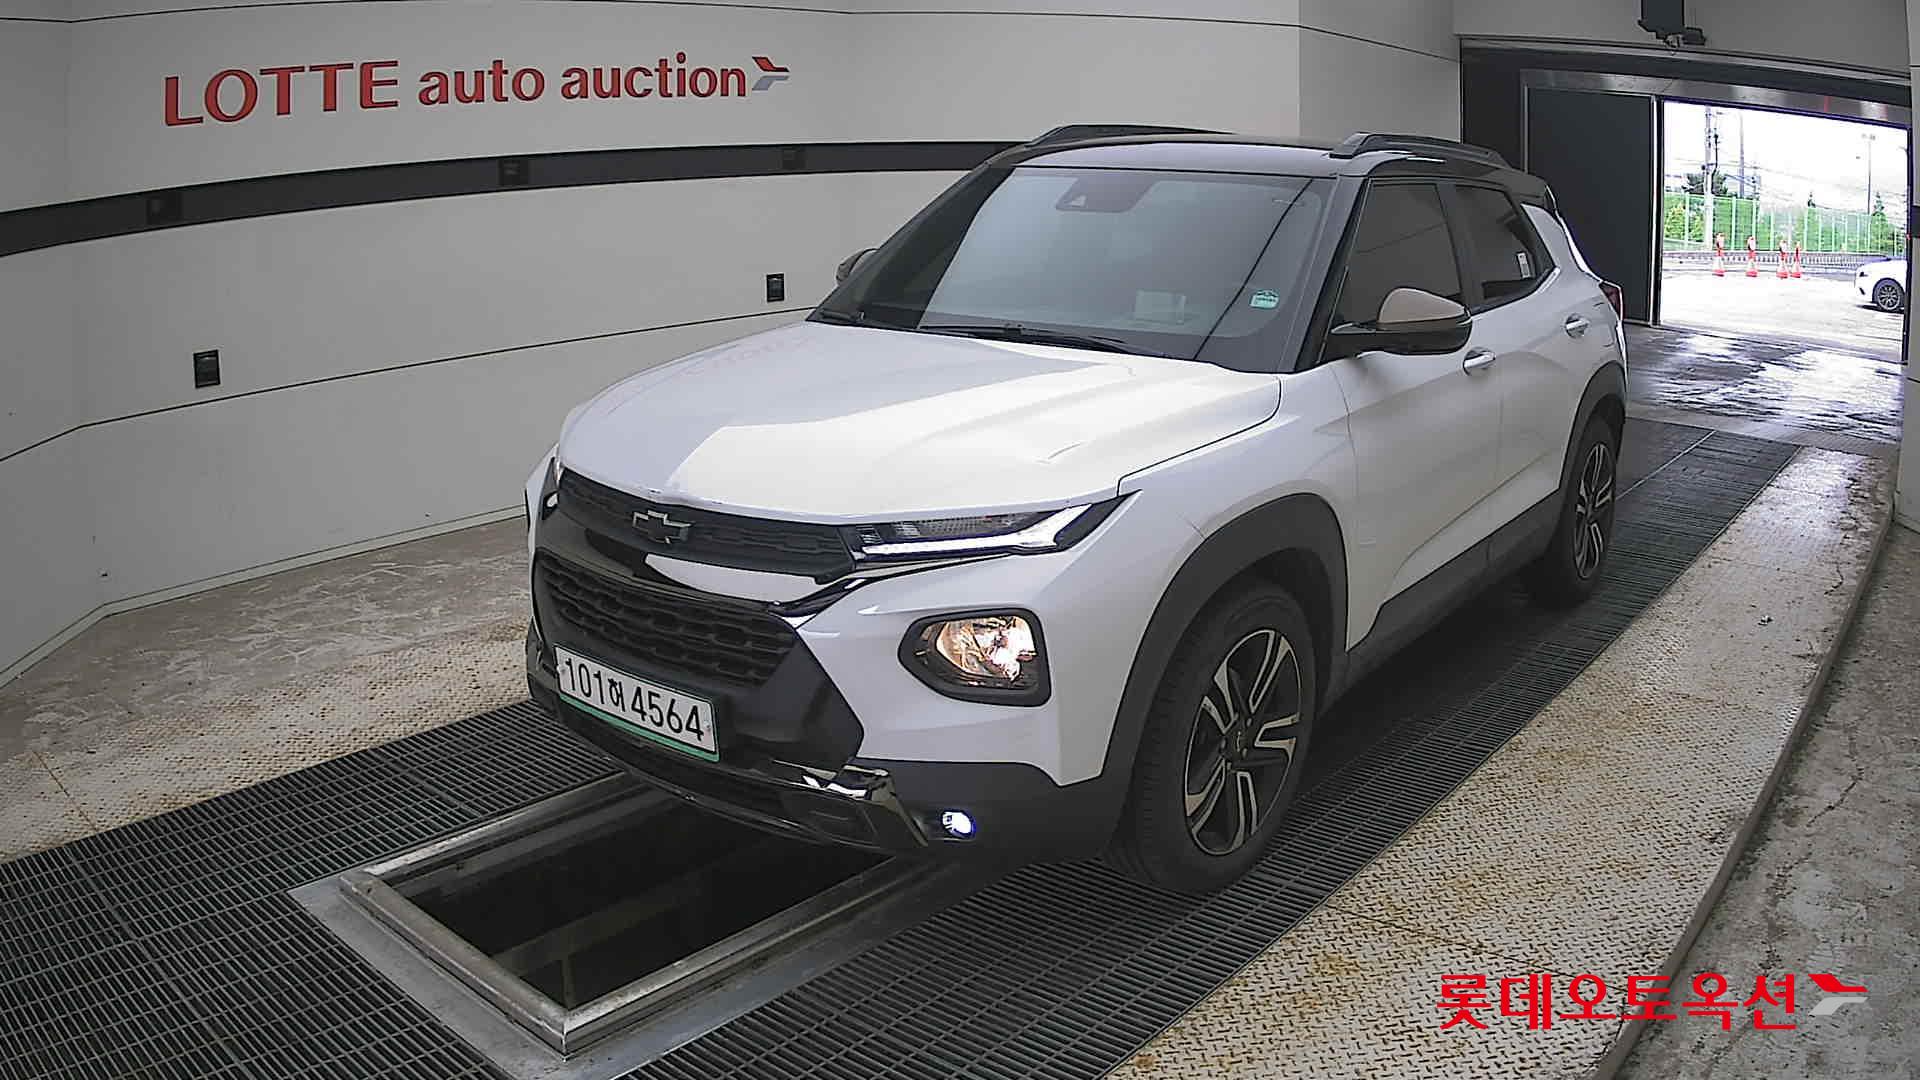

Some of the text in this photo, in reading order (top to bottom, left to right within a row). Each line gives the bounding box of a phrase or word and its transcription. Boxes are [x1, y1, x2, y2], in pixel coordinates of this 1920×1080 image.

[164, 51, 748, 127] LOTTE auto auction
